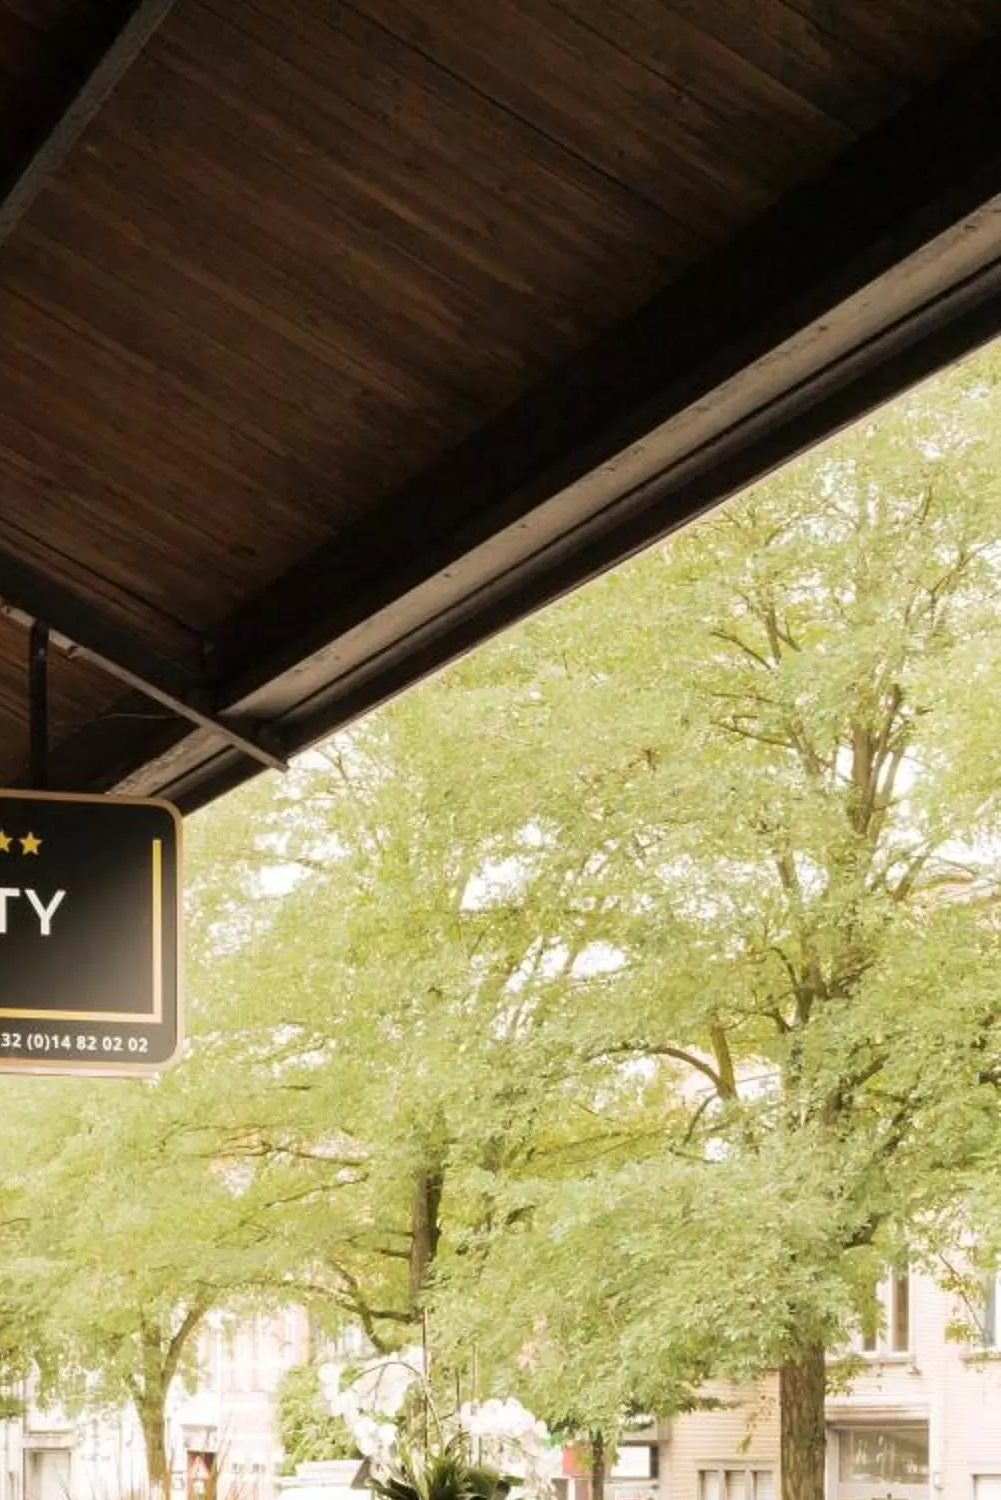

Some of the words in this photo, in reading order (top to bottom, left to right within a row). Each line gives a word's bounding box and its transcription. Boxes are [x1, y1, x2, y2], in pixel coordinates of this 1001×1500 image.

[26, 1033, 71, 1051] (0)14
[76, 1035, 97, 1051] 82
[102, 1036, 124, 1052] 02
[128, 1037, 149, 1053] 02
